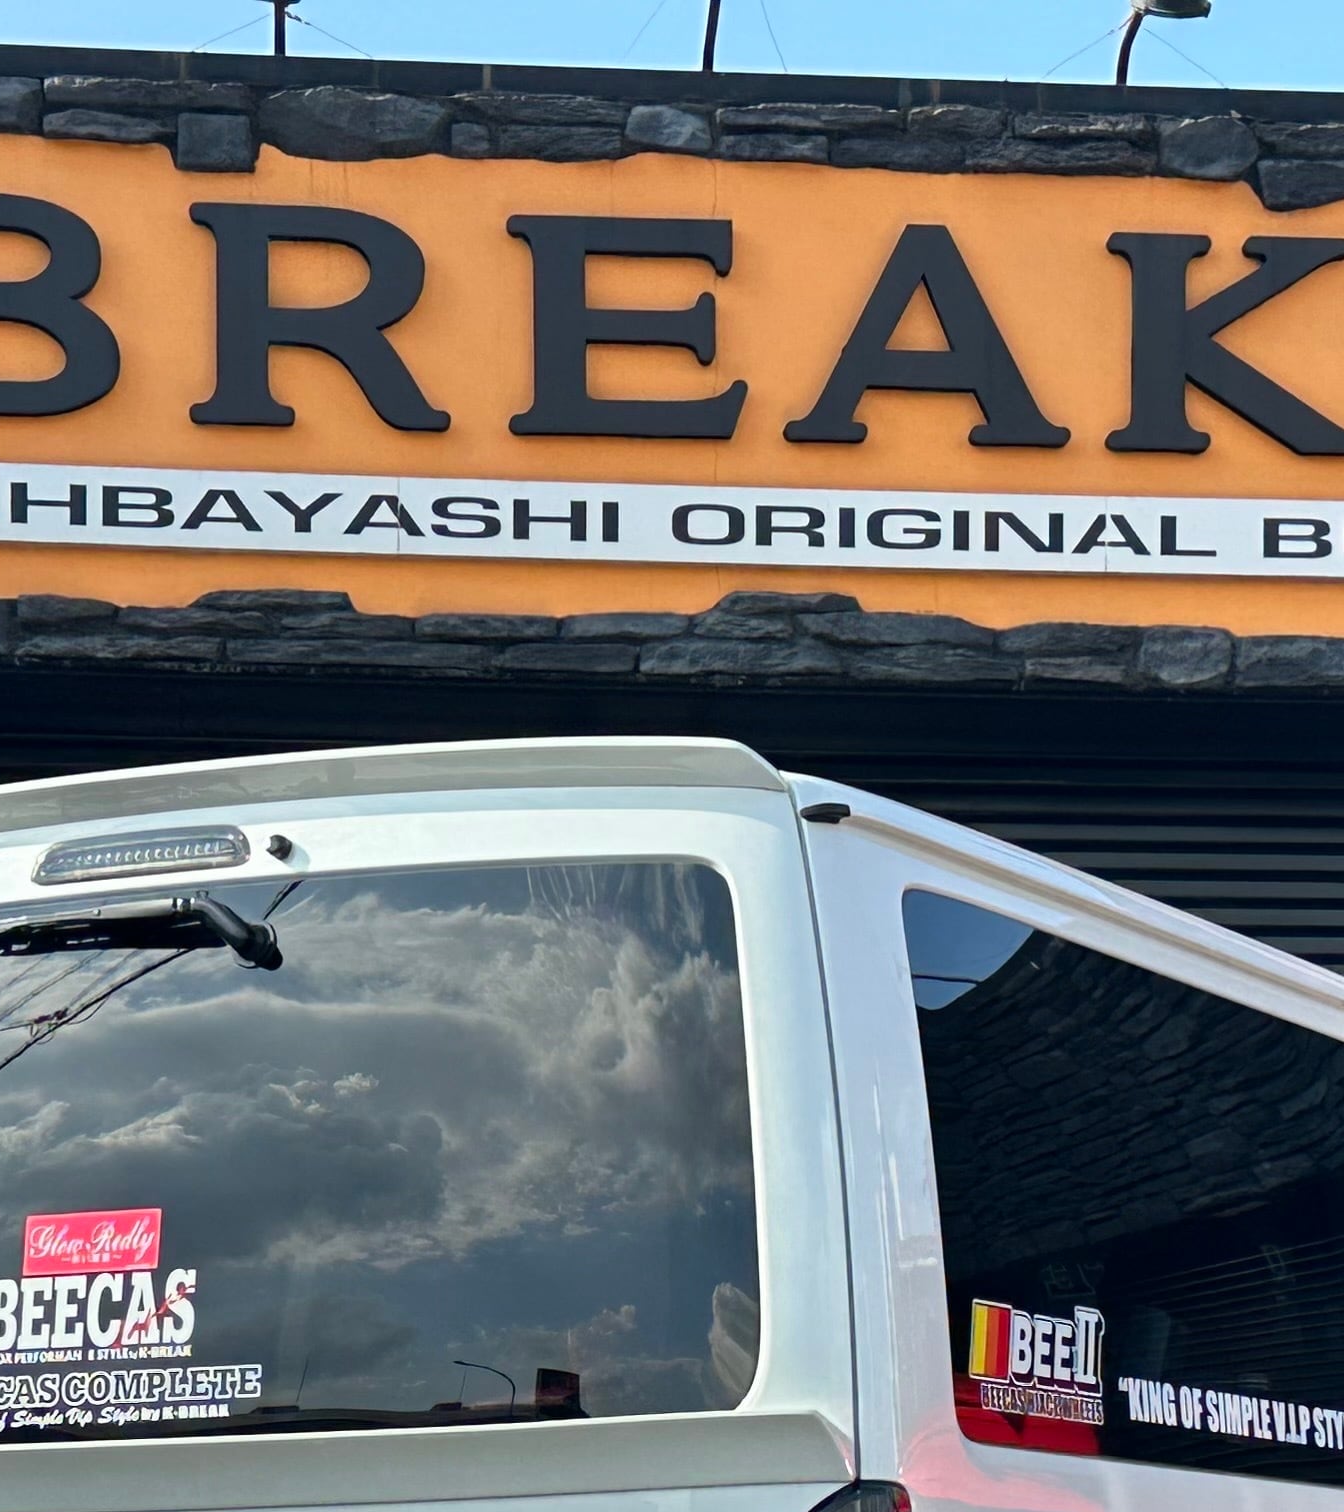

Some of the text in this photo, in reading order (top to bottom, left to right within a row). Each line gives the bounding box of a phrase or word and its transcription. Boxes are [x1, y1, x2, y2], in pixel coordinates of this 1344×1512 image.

[671, 503, 1216, 559] ORIGINAL
[62, 1364, 262, 1406] COMPLETE
[10, 1409, 64, 1430] Simple
[97, 1405, 140, 1427] Style
[1179, 1386, 1203, 1430] OF
[1205, 1389, 1272, 1440] SIMPLE
